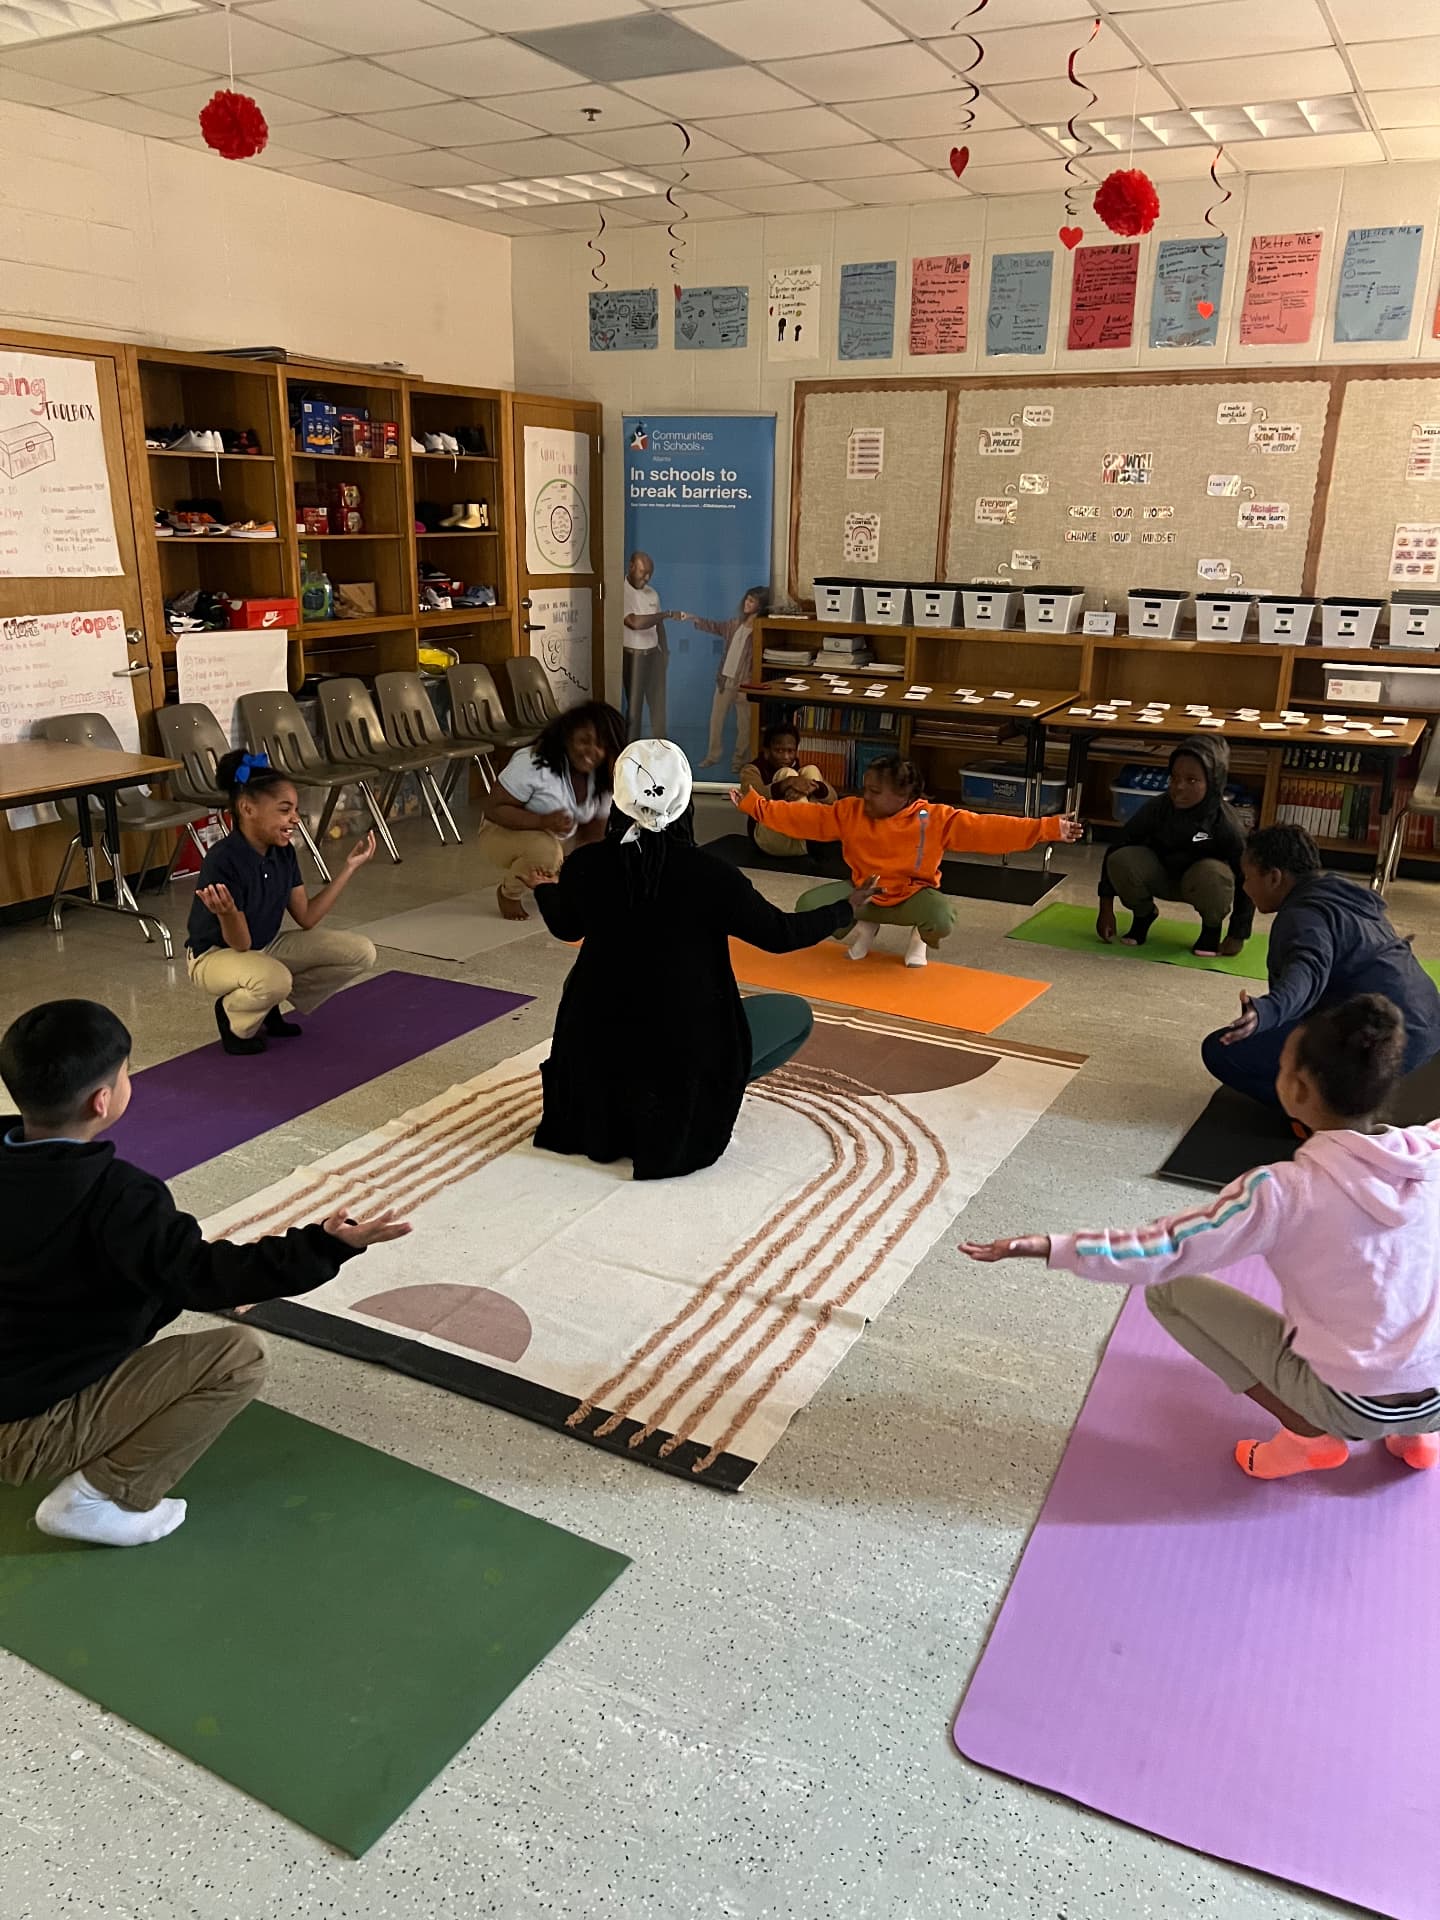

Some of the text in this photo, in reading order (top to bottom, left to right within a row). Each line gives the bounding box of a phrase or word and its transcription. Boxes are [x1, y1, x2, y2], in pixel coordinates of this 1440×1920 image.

[1260, 236, 1293, 249] Better
[39, 401, 95, 422] TOOLBOX
[652, 430, 714, 441] Communities
[652, 441, 701, 451] In Schools
[992, 439, 1021, 447] PRACTICE
[1103, 453, 1152, 468] GROWTH
[630, 467, 737, 482] In schools to
[630, 484, 752, 499] break barriers.
[1241, 513, 1255, 522] help
[1066, 531, 1097, 541] CHANGE
[1142, 533, 1177, 543] MINDSET
